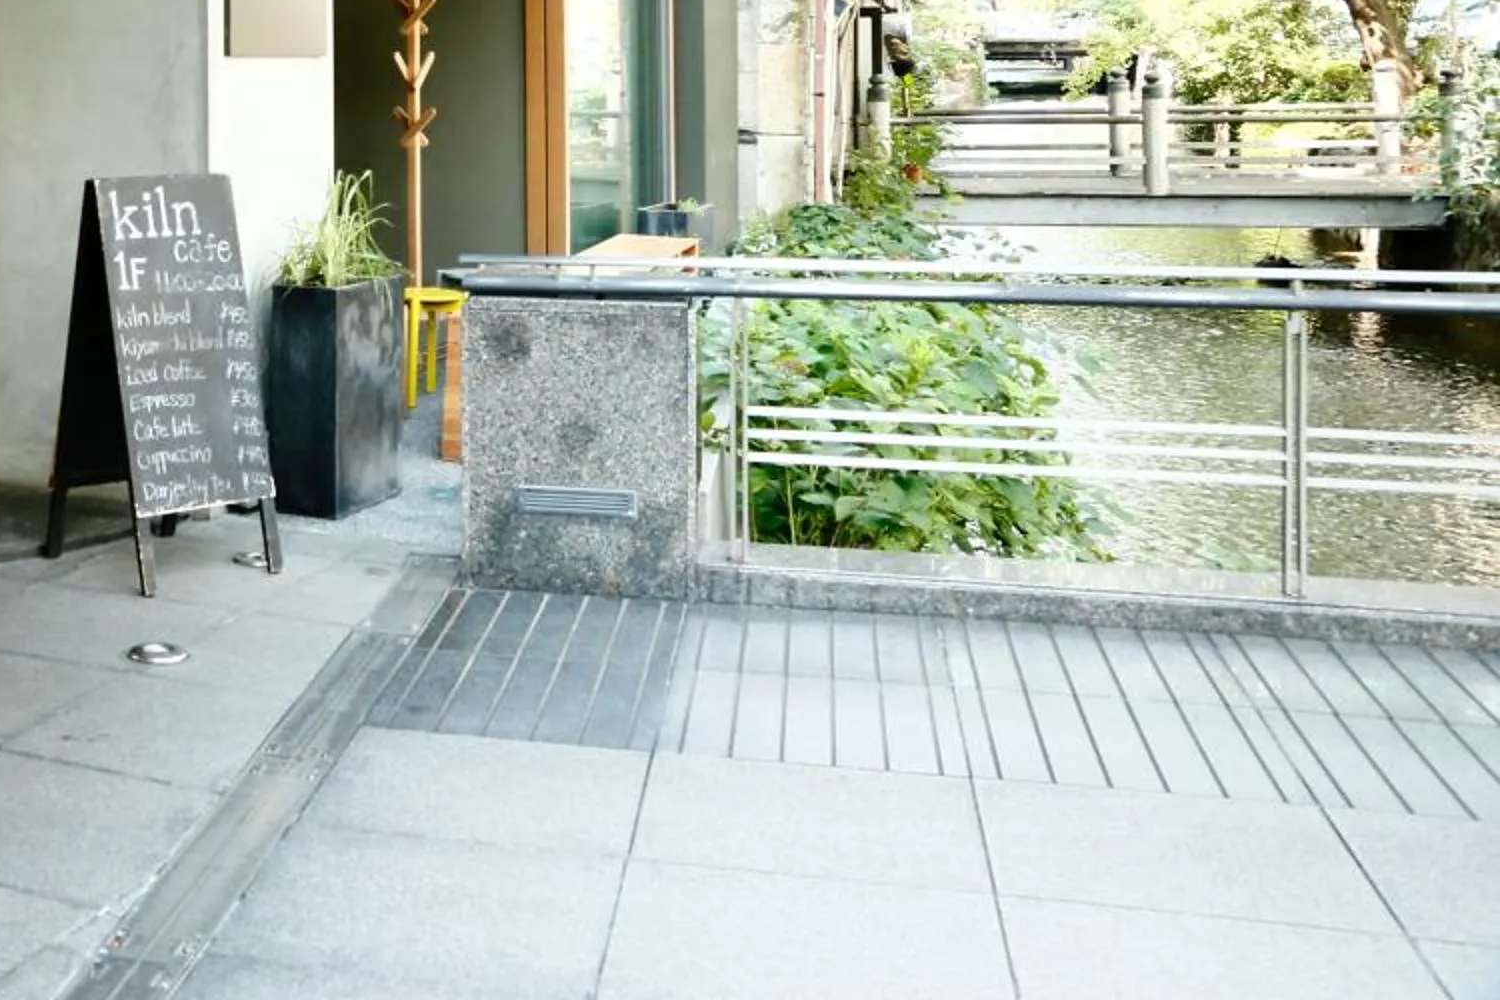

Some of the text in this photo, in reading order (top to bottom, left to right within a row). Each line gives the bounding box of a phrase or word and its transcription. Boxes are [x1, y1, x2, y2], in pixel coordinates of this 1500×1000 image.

[109, 185, 202, 241] kiln
[173, 232, 233, 263] cafe
[113, 250, 148, 291] 1F
[115, 302, 150, 329] kiln
[130, 393, 196, 413] Espresso
